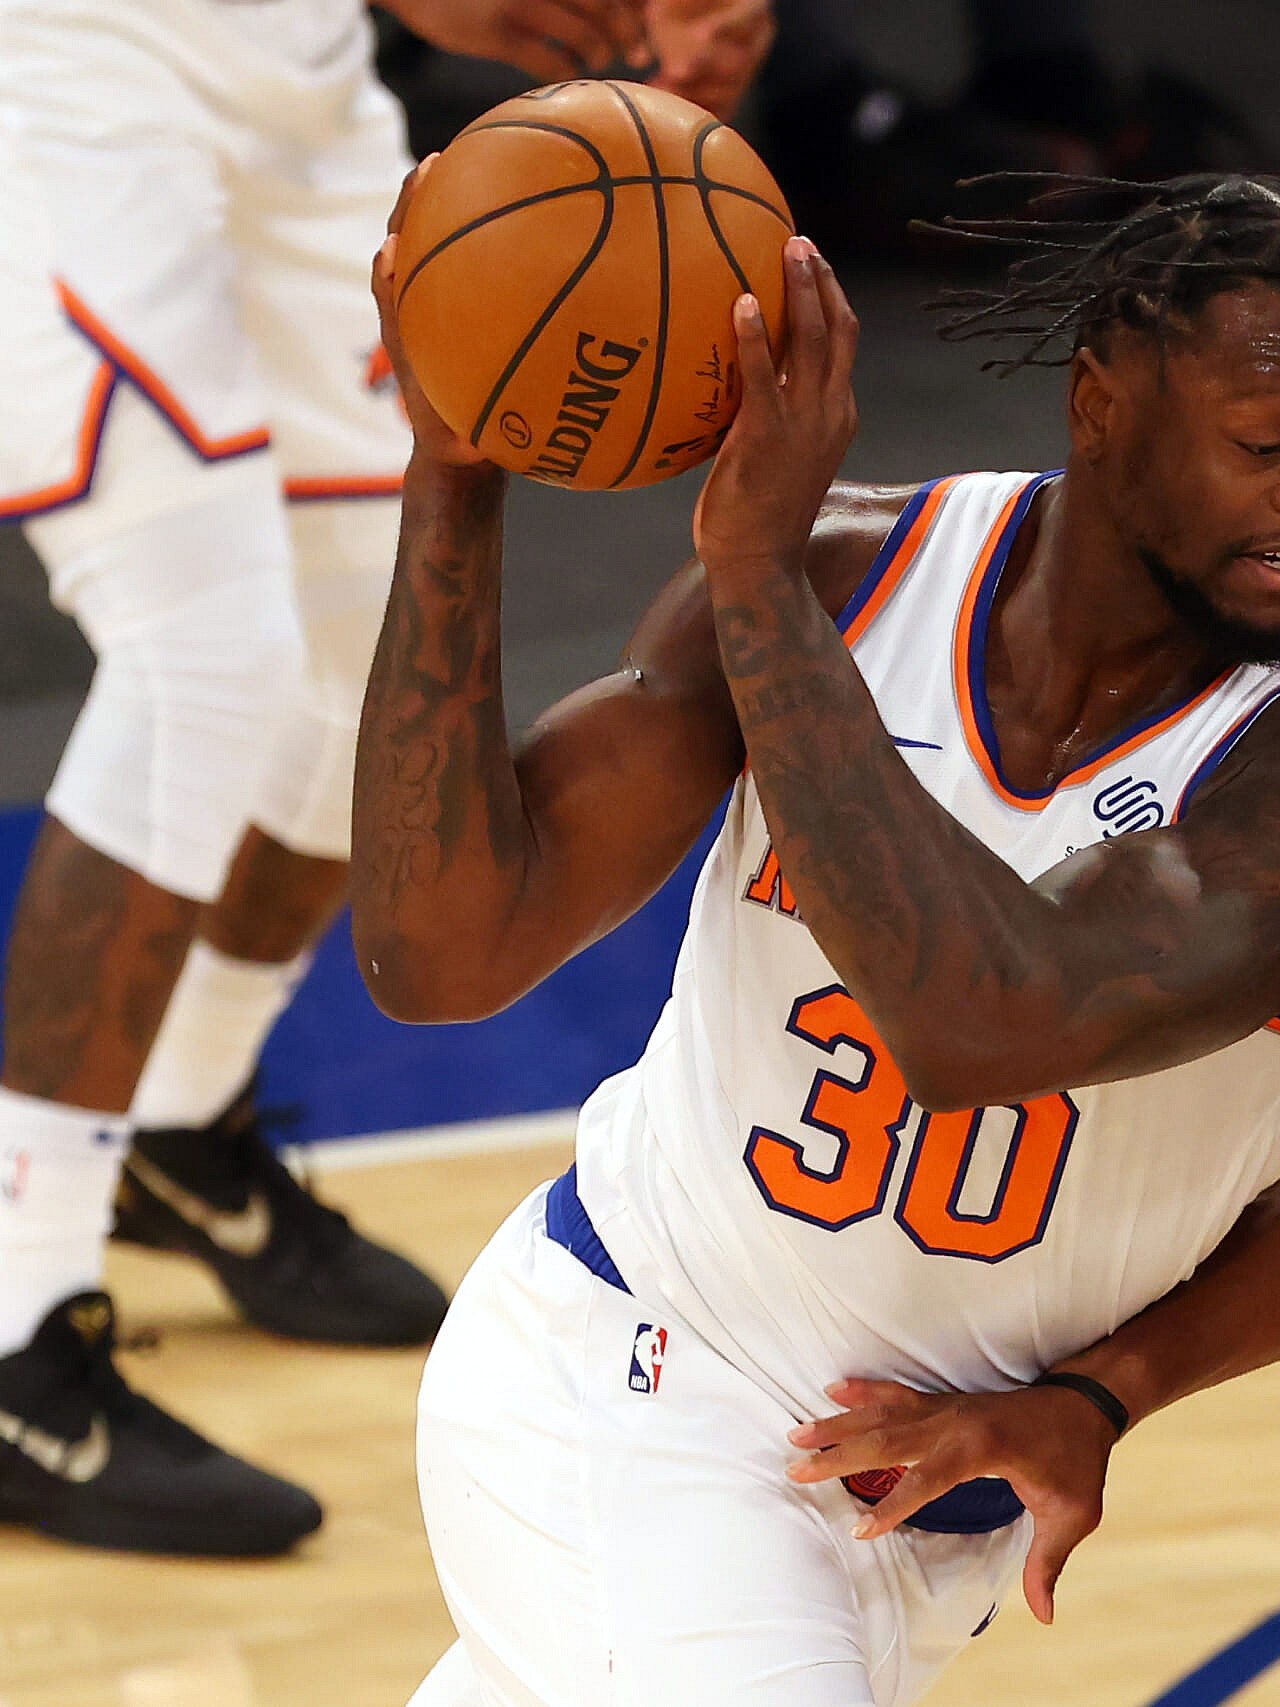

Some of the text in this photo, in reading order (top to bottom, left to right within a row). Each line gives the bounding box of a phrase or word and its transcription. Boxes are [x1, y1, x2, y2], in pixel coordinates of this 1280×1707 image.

[526, 332, 642, 481] ALDING
[743, 983, 1080, 1264] 30
[630, 1374, 648, 1391] NBA
